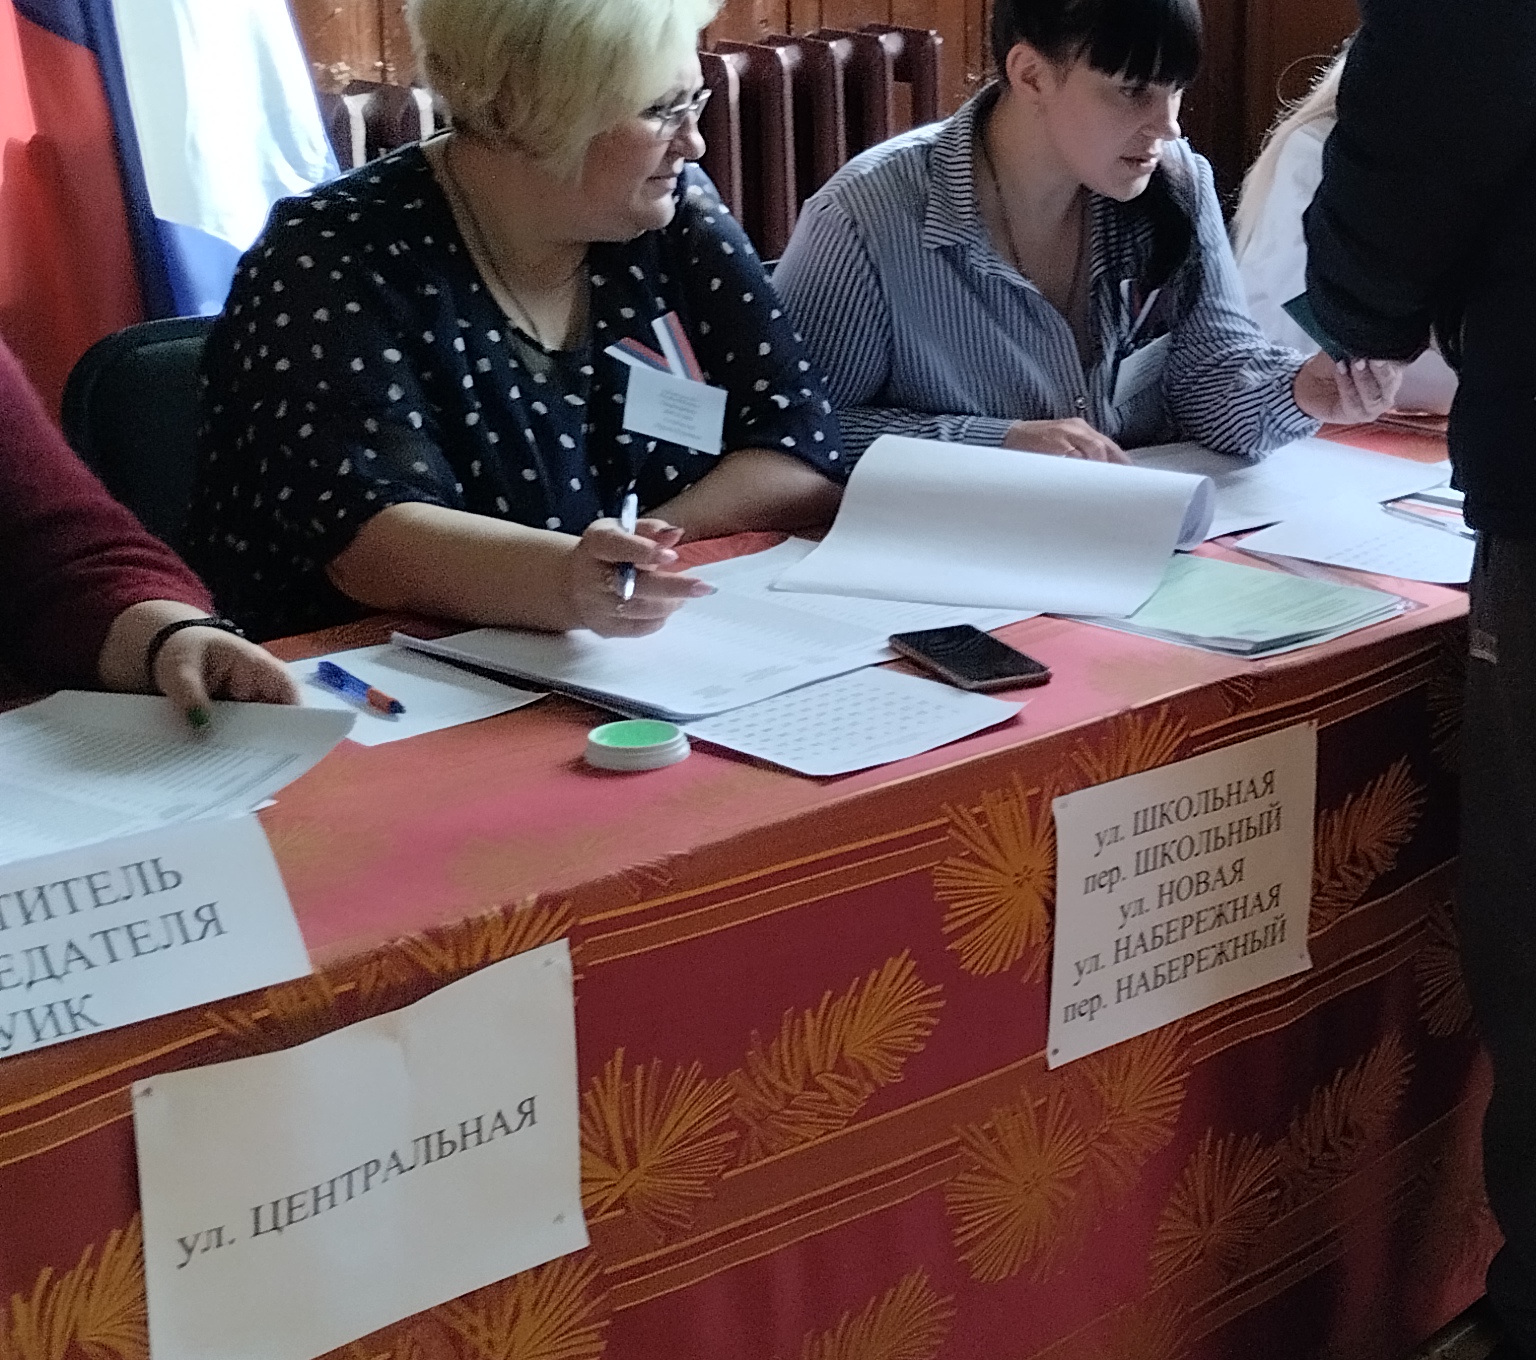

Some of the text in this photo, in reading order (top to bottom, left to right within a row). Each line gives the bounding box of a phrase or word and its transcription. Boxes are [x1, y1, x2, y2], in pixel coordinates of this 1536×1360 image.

[1083, 800, 1283, 896] пер. ШКОЛЬНЫЙ
[1094, 769, 1277, 857] ул. ШКОЛЬНАЯ
[1072, 883, 1283, 987] ул. НАБЕРЕЖНАЯ
[1117, 857, 1246, 930] ул. НОВАЯ
[1062, 912, 1288, 1024] пер. НАБЕРЕЖНЫЙ
[176, 1094, 539, 1270] ул. ЦЕНТРАЛЬНАЯ
